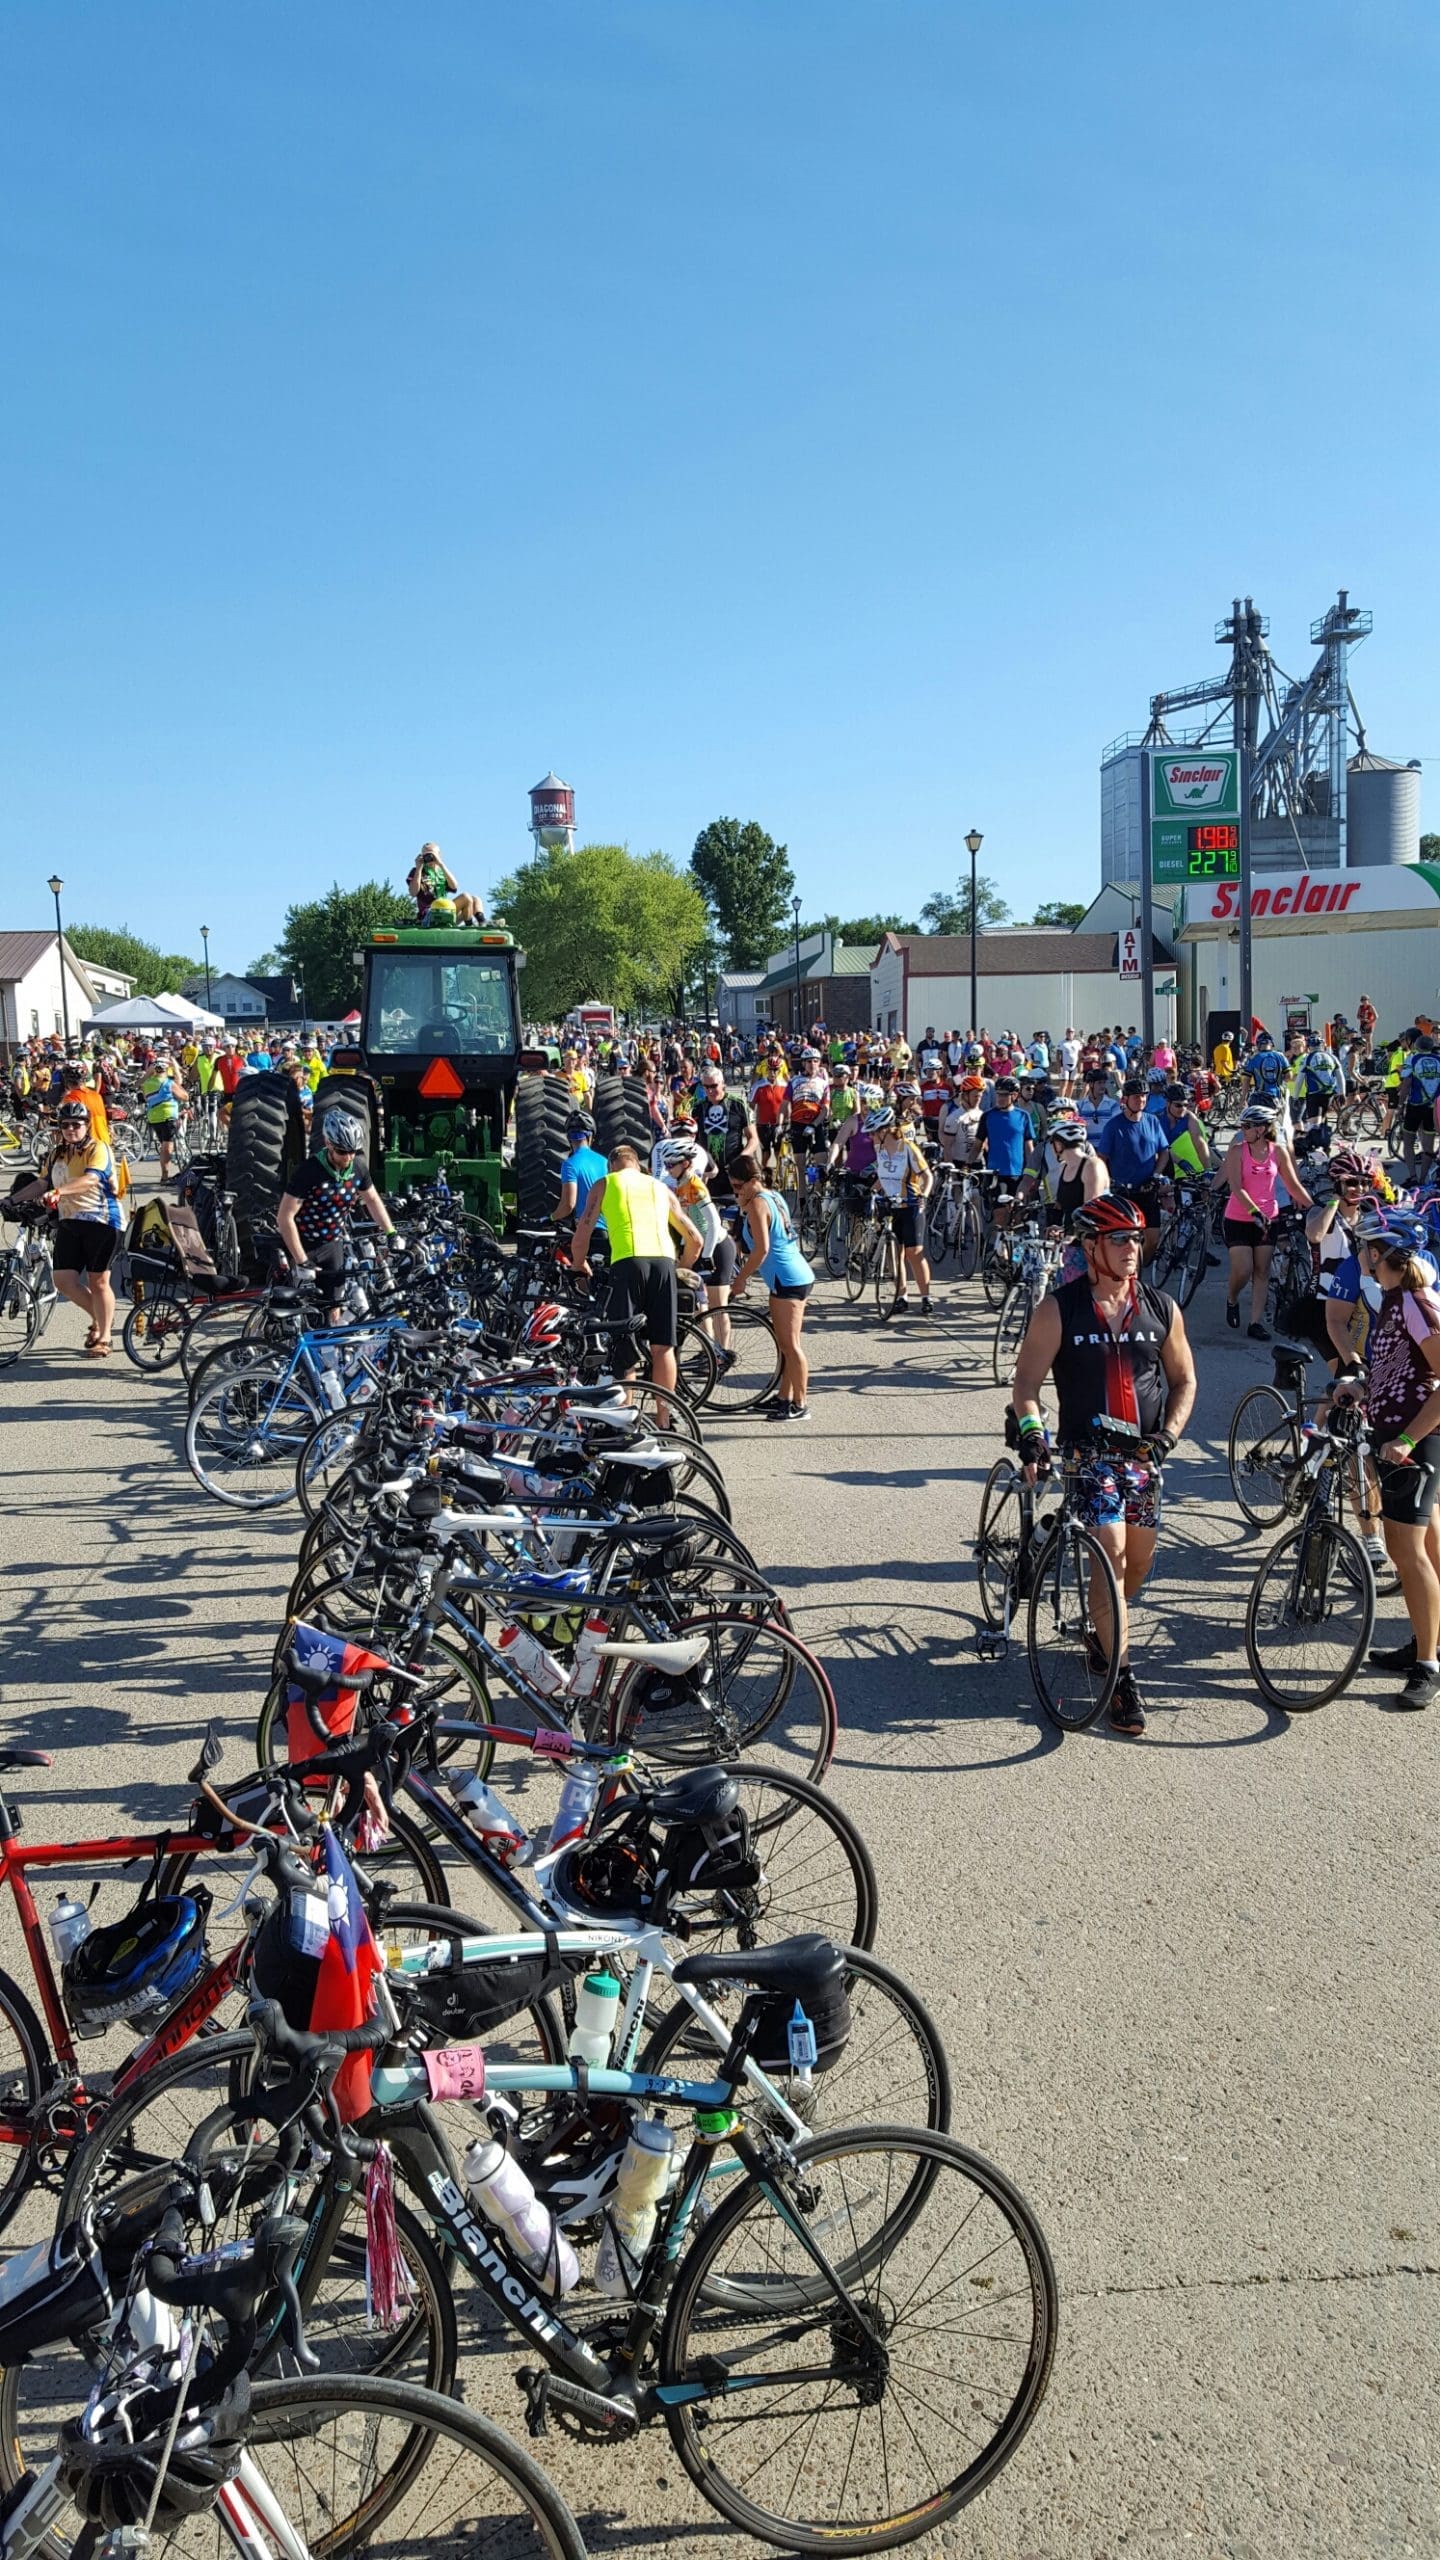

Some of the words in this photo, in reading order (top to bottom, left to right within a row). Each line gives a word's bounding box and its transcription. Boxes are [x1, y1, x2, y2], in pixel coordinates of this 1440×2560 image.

[1169, 766, 1224, 784] Sinclair
[1159, 860, 1184, 868] DIESEL
[1211, 875, 1361, 919] Snclair
[1073, 1331, 1158, 1346] PRIMAL
[461, 1624, 529, 1693] KLEIN
[441, 2008, 466, 2017] deuter
[432, 2176, 563, 2342] Bianchi
